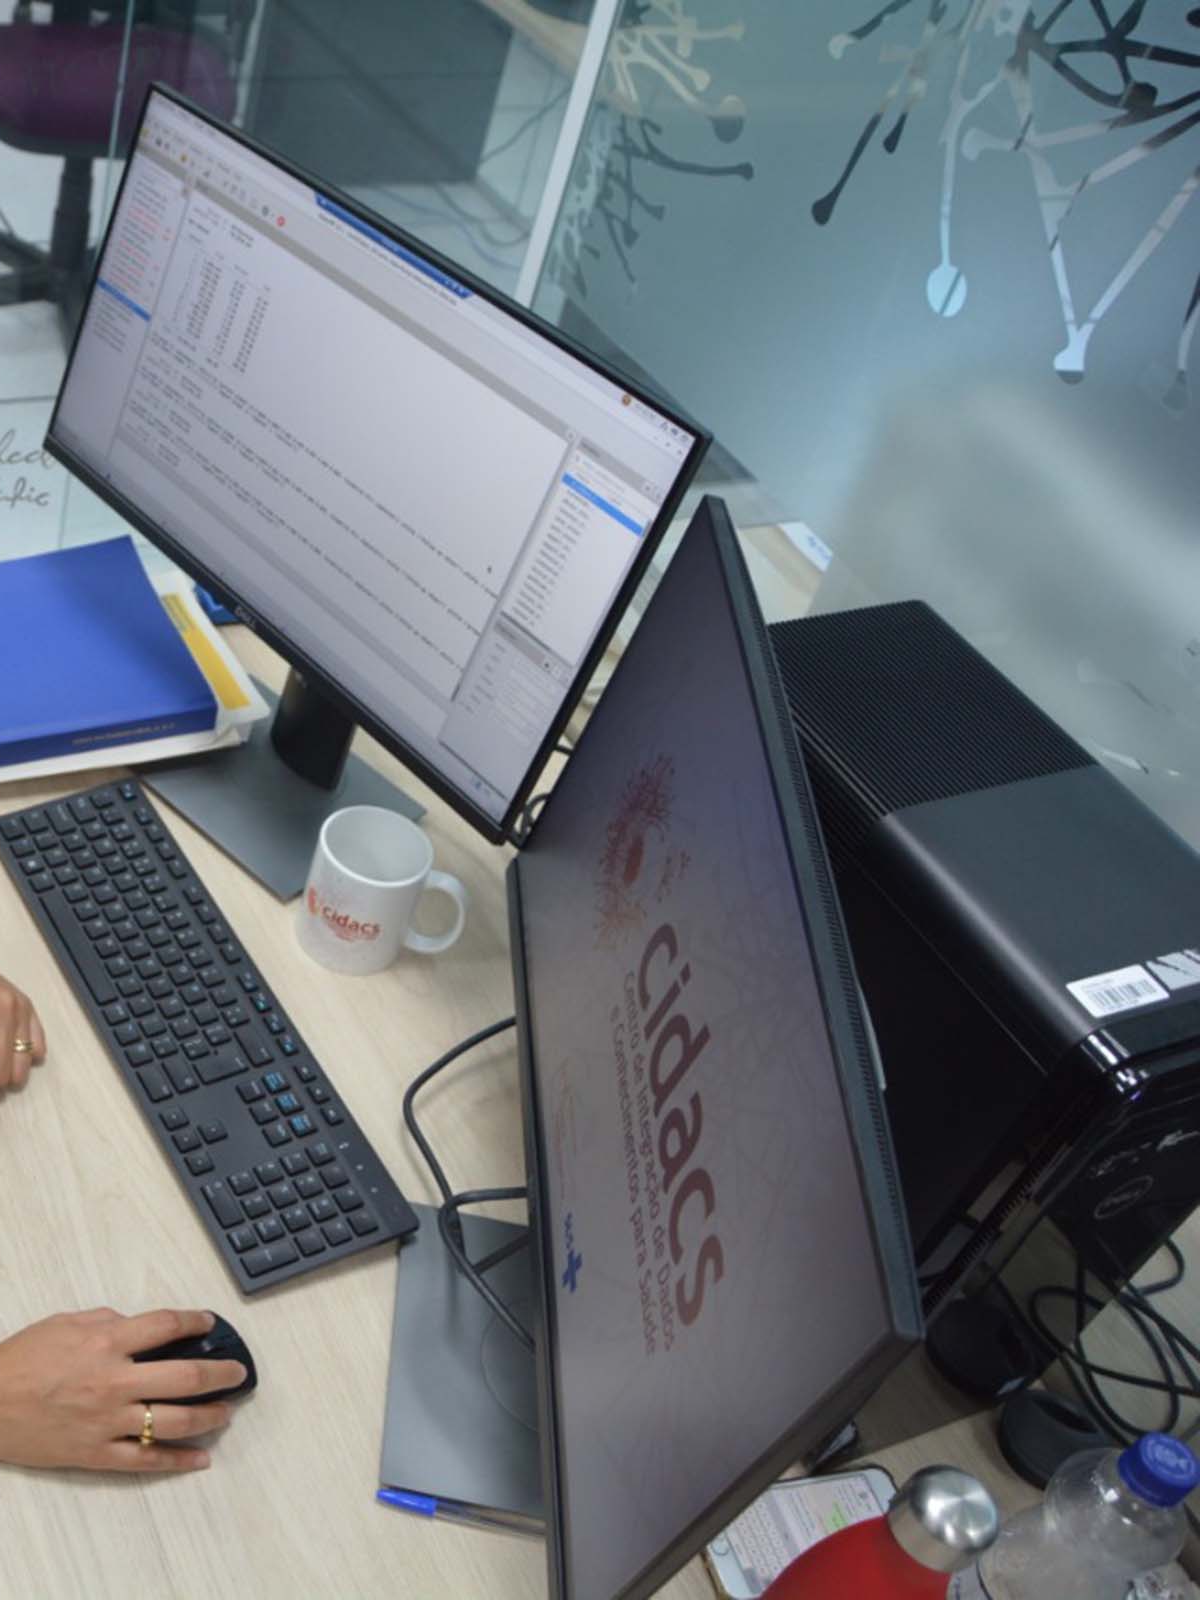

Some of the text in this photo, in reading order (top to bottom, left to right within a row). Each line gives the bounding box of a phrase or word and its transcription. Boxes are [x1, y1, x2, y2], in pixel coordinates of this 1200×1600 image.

[321, 905, 381, 935] cidacs
[624, 971, 641, 1049] Centro
[633, 1053, 645, 1085] de
[614, 1023, 640, 1204] Conhecimentos
[630, 1206, 648, 1268] para
[638, 923, 724, 1326] cidacs
[653, 1225, 665, 1259] de
[657, 1264, 675, 1352] Dados
